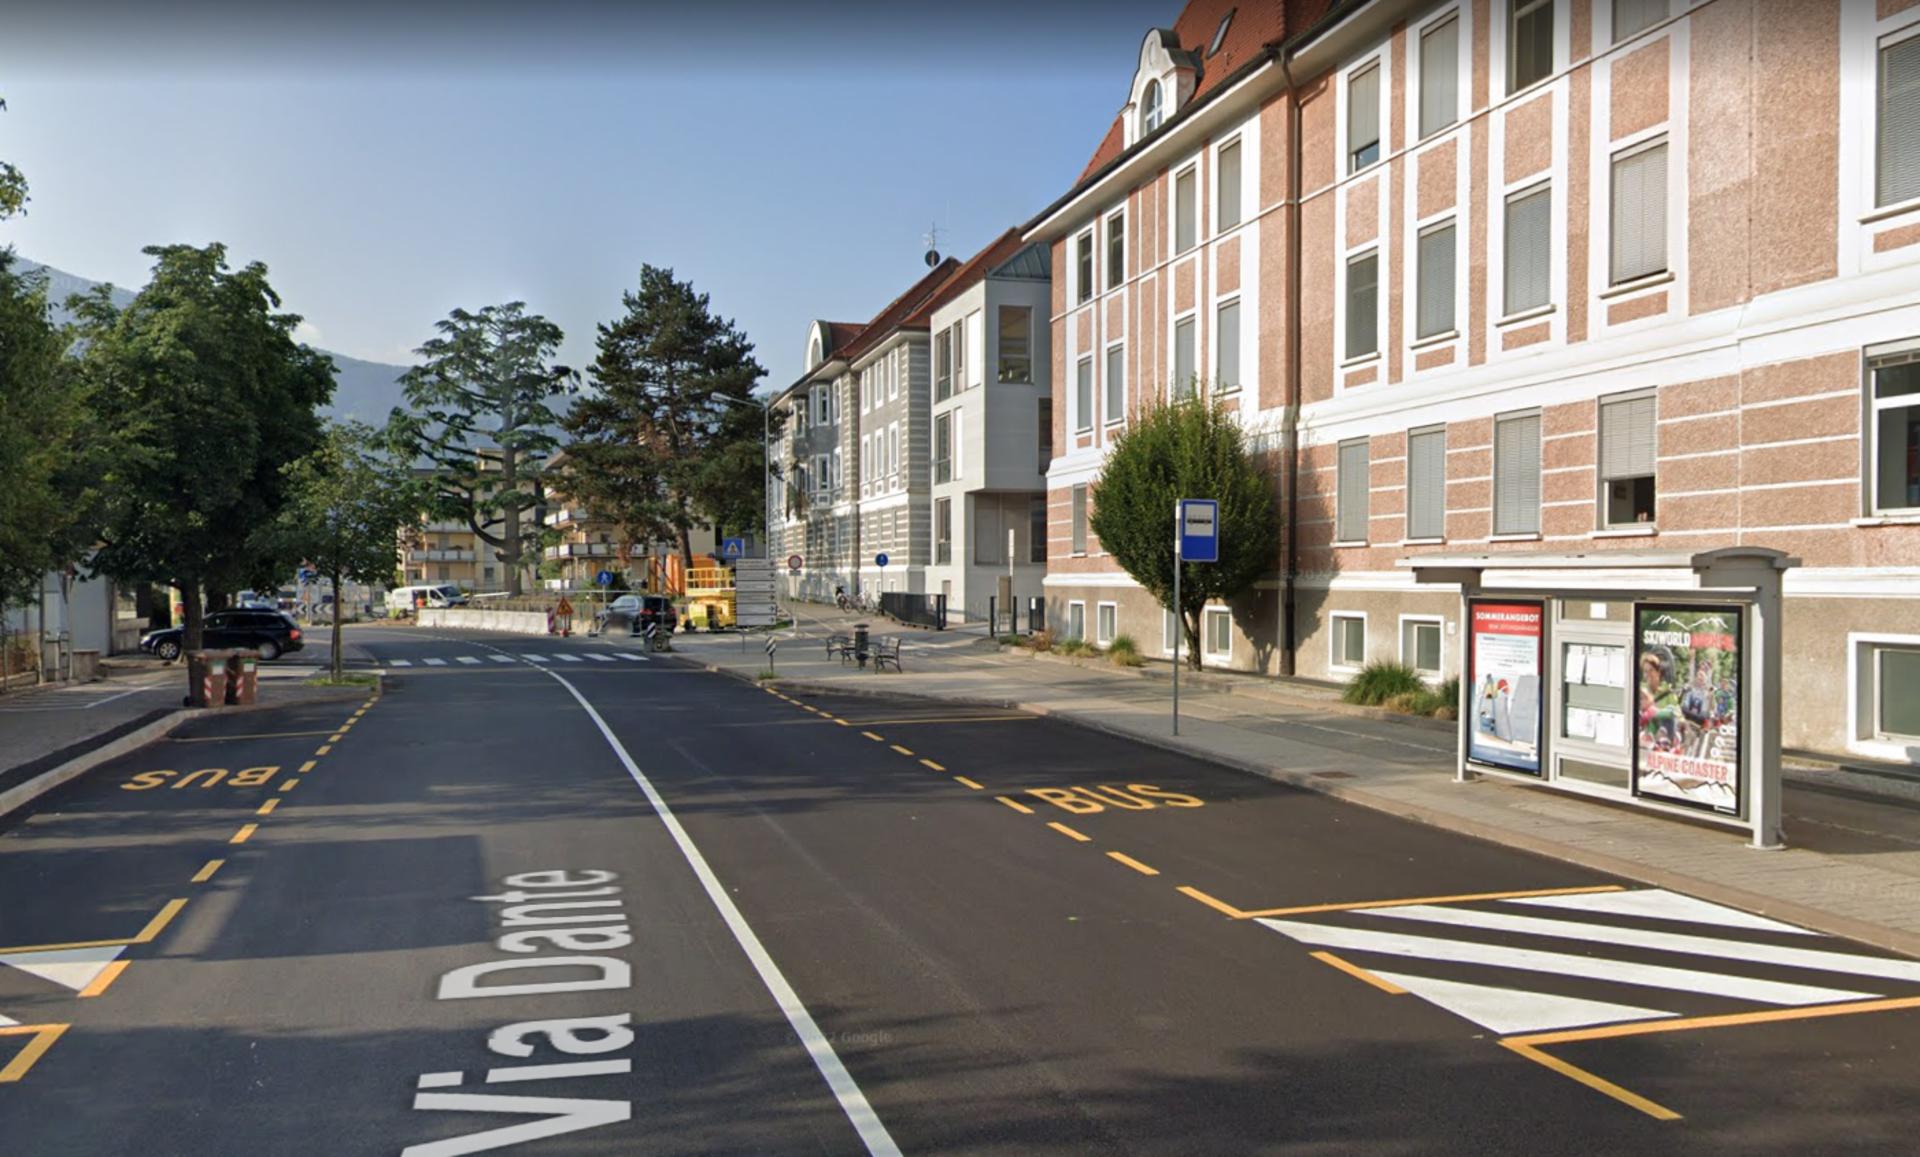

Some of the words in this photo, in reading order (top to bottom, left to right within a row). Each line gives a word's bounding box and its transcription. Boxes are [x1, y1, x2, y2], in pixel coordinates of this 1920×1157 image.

[120, 765, 281, 791] BUS
[1647, 753, 1680, 773] ALPINE
[1681, 759, 1729, 783] COASTER
[1024, 783, 1205, 814] BUS
